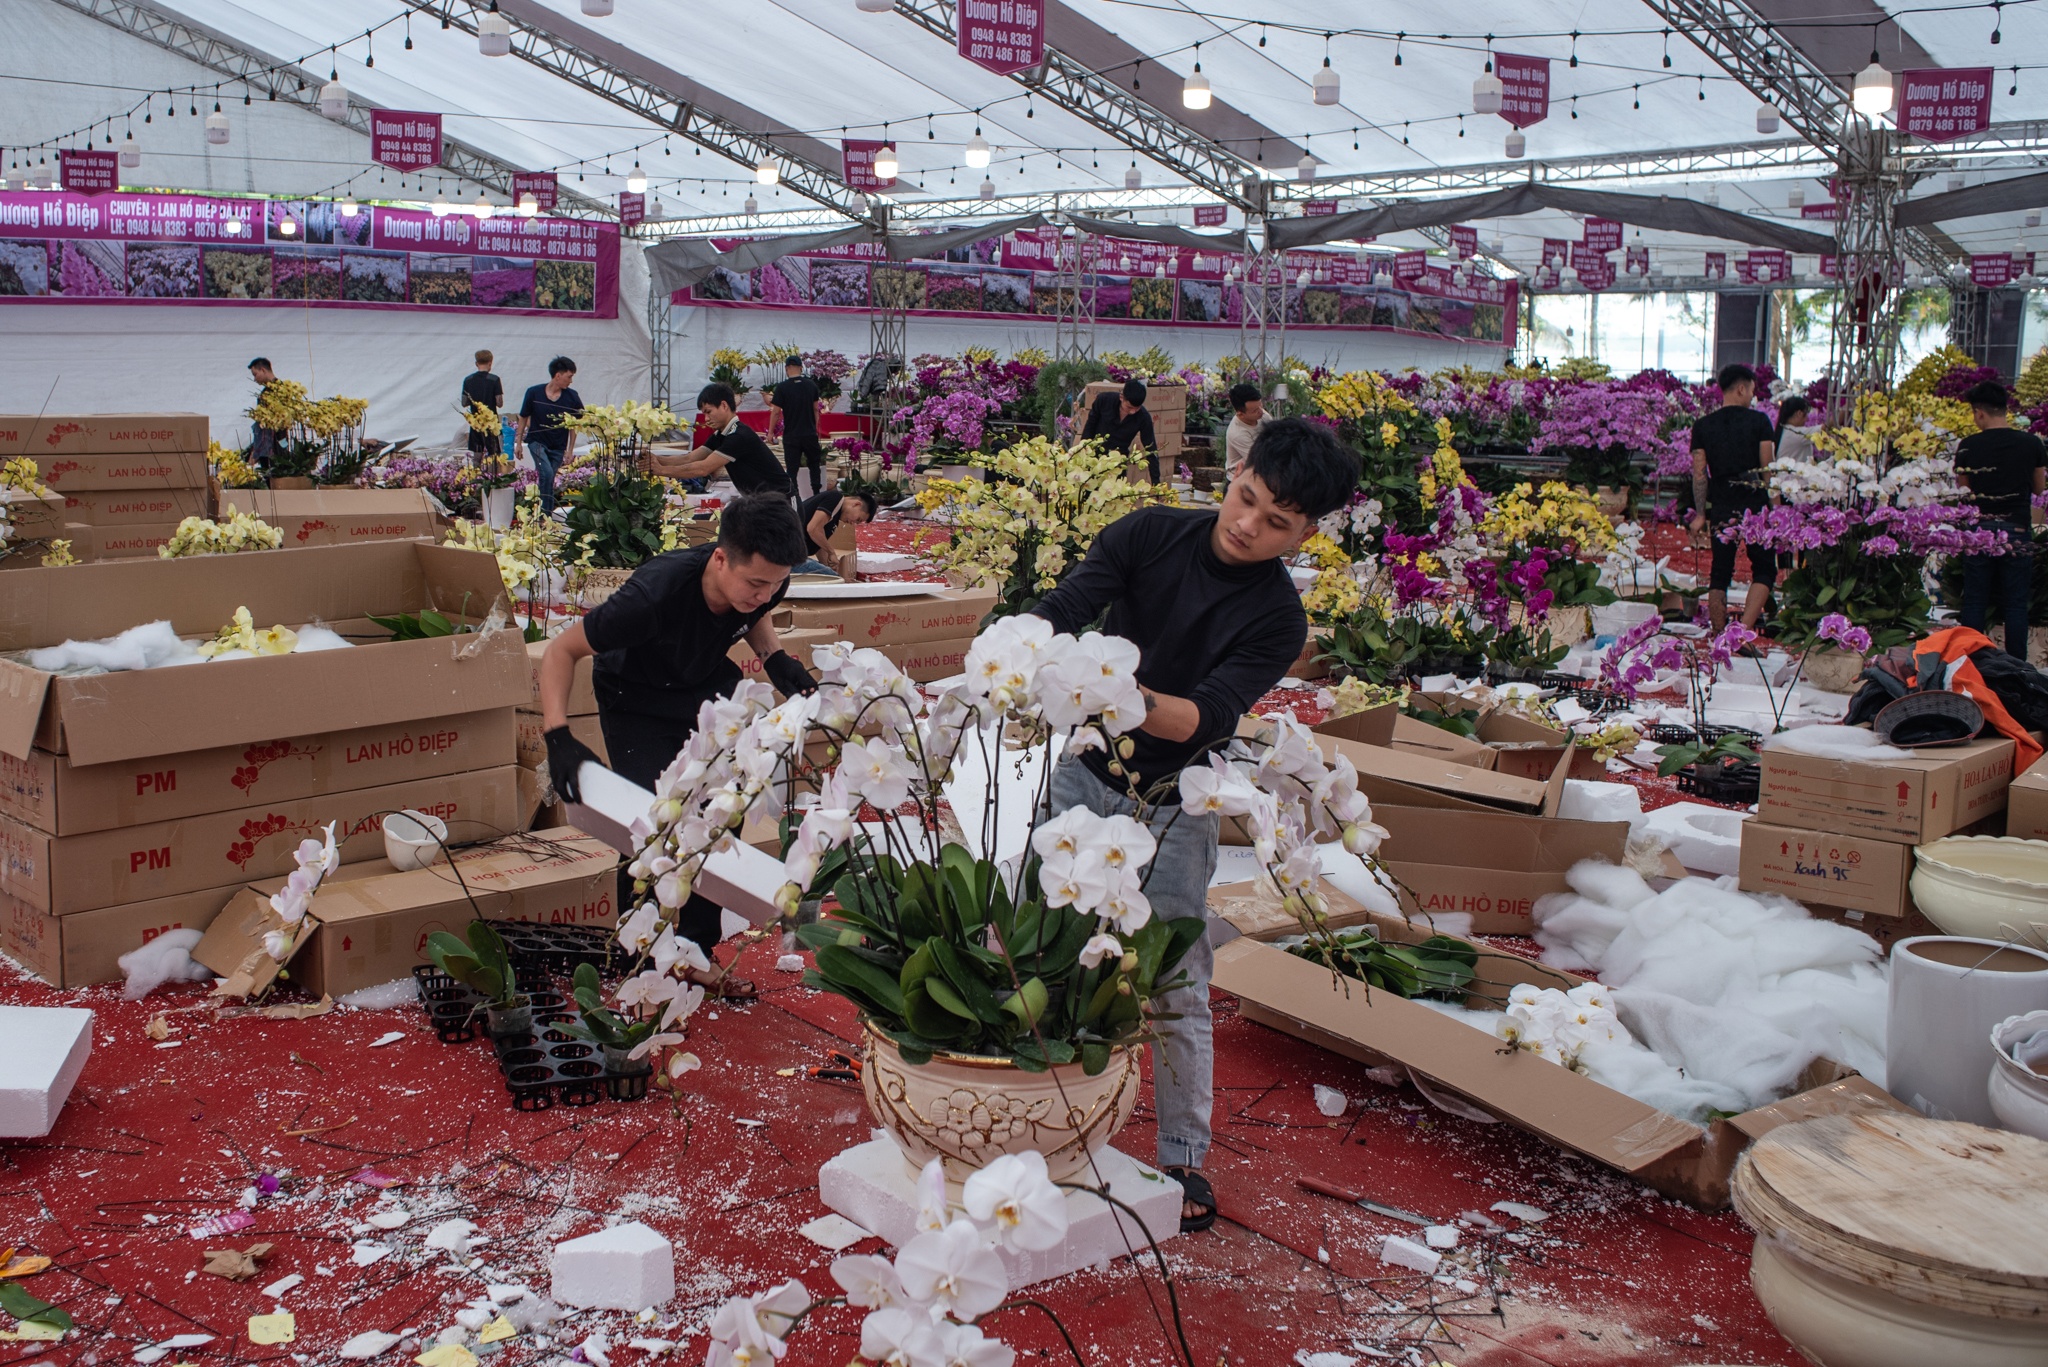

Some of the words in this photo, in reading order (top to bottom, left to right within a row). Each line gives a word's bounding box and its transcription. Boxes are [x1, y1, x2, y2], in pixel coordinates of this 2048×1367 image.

[966, 0, 998, 24] Dương
[1016, 3, 1037, 30] Điệp
[972, 27, 994, 42] 0948
[996, 31, 1008, 44] 44
[1010, 32, 1032, 47] 8383
[971, 44, 993, 59] 0879
[996, 47, 1012, 61] 486
[1016, 49, 1031, 64] 186
[1500, 66, 1520, 80] Dương
[1503, 85, 1518, 96] 0948
[1520, 86, 1526, 97] 44
[1528, 87, 1543, 98] 8383
[1907, 84, 1940, 102] Dương
[1942, 79, 1957, 99] Hồ
[1959, 81, 1985, 103] Điệp
[1502, 99, 1517, 111] 0879
[1519, 100, 1530, 112] 486
[1531, 102, 1542, 113] 186
[1910, 106, 1933, 117] 0948
[1936, 106, 1949, 117] 44
[1952, 106, 1977, 117] 8383
[376, 120, 402, 138] Dương
[417, 123, 435, 141] Điệp
[1909, 120, 1932, 131] 0879
[1935, 120, 1954, 131] 486
[1957, 120, 1976, 130] 186
[381, 141, 399, 150] 0948
[402, 142, 411, 151] 44
[413, 143, 431, 152] 8383
[381, 152, 399, 162] 0879
[402, 153, 415, 163] 486
[418, 154, 431, 164] 186
[69, 169, 84, 177] 0948
[95, 170, 110, 178] 8383
[866, 167, 873, 175] 44
[86, 179, 97, 187] 486
[851, 176, 864, 184] 0879
[866, 177, 876, 185] 486
[44, 199, 62, 226] Hồ
[66, 203, 99, 232] Điệp
[110, 198, 149, 216] CHUYÊN
[158, 202, 177, 217] LAN
[195, 202, 217, 221] ĐIỆP
[110, 218, 124, 234] LH:
[127, 219, 149, 235] 0948
[152, 220, 163, 236] 44
[165, 220, 186, 237] 8383
[195, 221, 216, 237] 0879
[384, 216, 422, 242] Dương
[425, 217, 441, 240] Hồ
[480, 219, 512, 234] CHUYÊN
[550, 222, 568, 239] ĐIỆP
[583, 227, 598, 242] LẠT
[478, 236, 490, 250] LH:
[492, 237, 510, 252] 0948
[512, 238, 521, 252] 44
[523, 239, 541, 254] 8383
[548, 241, 565, 255] 0879
[567, 242, 580, 256] 486
[584, 243, 596, 257] 186
[1011, 237, 1041, 260] Dương
[109, 431, 130, 440] LAN
[133, 429, 147, 440] HỒ
[150, 430, 173, 441] ĐIỆP
[108, 469, 129, 477] LAN
[132, 466, 146, 476] HỒ
[149, 466, 172, 478] ĐIỆP
[109, 504, 129, 513] LAN
[132, 502, 146, 512] HỒ
[149, 502, 172, 513] ĐIỆP
[350, 527, 368, 535] LAN
[371, 524, 384, 534] HỒ
[386, 525, 406, 536] ĐIỆP
[106, 541, 126, 550] LAN
[129, 538, 143, 548] HỒ
[146, 538, 169, 549] ĐIỆP
[922, 618, 939, 628] LAN
[942, 614, 954, 626] HỒ
[957, 613, 976, 626] ĐIỆP
[943, 653, 966, 666] ĐIỆP
[347, 742, 382, 763] LAN
[389, 733, 414, 756] HỒ
[418, 730, 458, 753] ĐIỆP
[1769, 767, 1787, 776] Người
[1964, 771, 1980, 789] HOA
[1981, 763, 1997, 782] LAN
[136, 770, 176, 796] PM
[1768, 783, 1786, 792] Người
[344, 815, 379, 836] LAN
[130, 846, 170, 873] PM
[472, 871, 504, 882] HOA
[505, 865, 540, 877] TƯƠI
[583, 892, 610, 920] HỒ
[1416, 893, 1455, 910] LAN
[1463, 892, 1491, 912] HỒ
[1497, 898, 1536, 919] ĐIỆ
